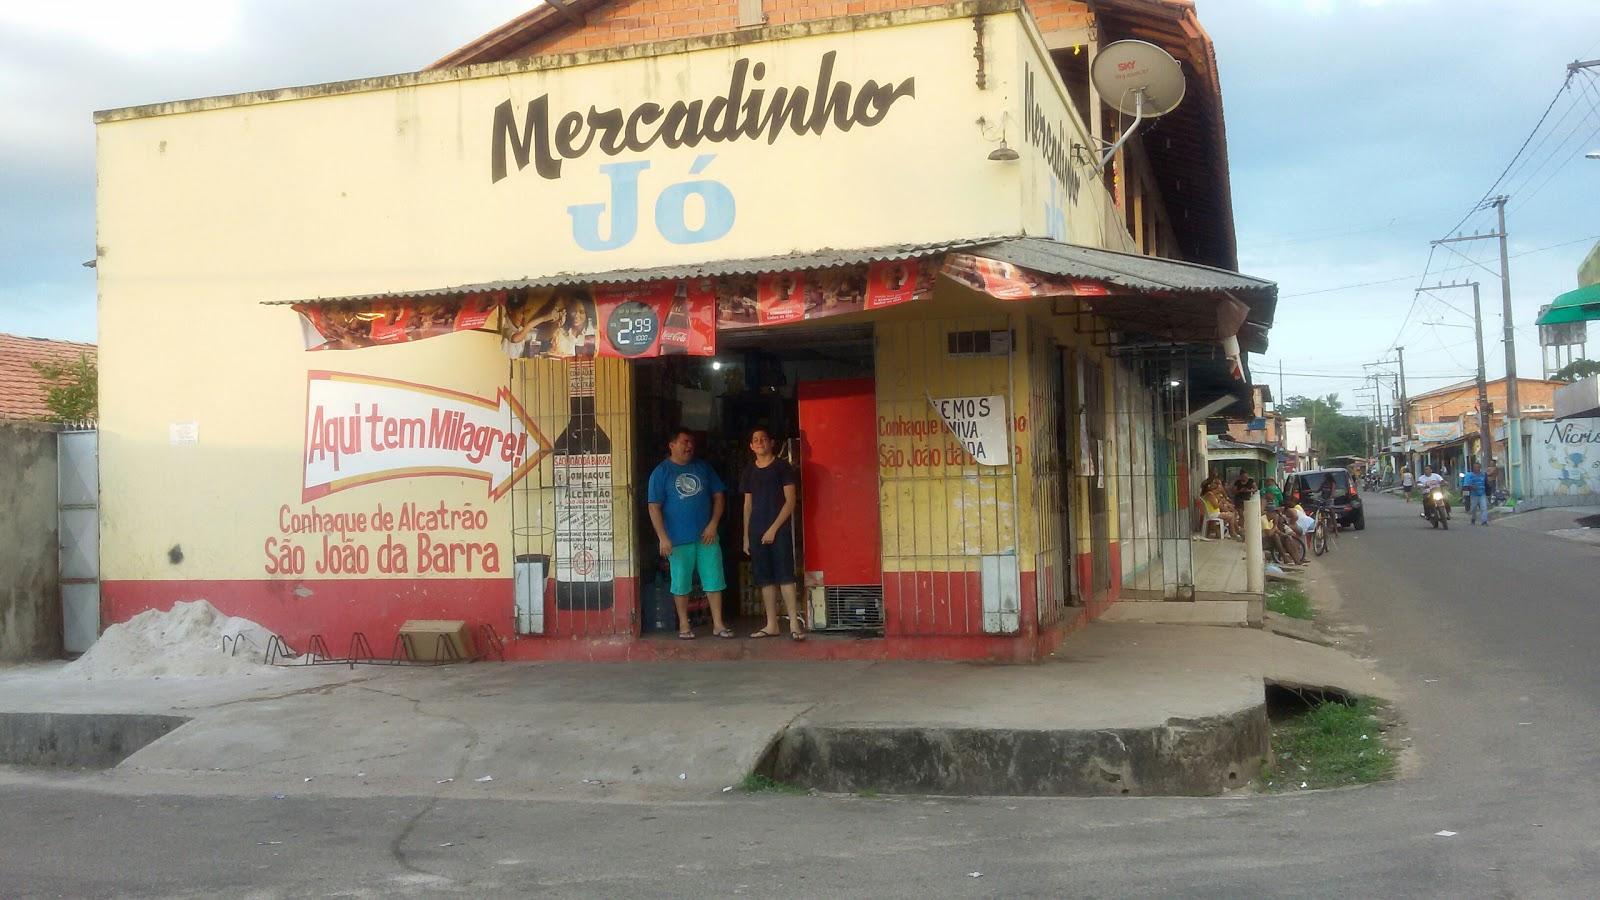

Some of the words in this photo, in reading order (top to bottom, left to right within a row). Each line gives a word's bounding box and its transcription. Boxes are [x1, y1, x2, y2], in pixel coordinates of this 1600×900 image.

[1117, 60, 1136, 71] SKY
[492, 50, 916, 184] Mercadinho
[1025, 61, 1081, 207] Mercadinho
[567, 154, 736, 252] Jó
[308, 403, 362, 471] Aqui
[365, 403, 426, 452] tem
[428, 408, 529, 468] Milagre!
[878, 415, 937, 441] Conhaque
[880, 443, 904, 467] São
[907, 442, 941, 467] João
[279, 504, 367, 542] Conhaque
[370, 503, 394, 531] de
[398, 500, 488, 531] Alcatrão
[264, 536, 305, 575] São
[315, 535, 369, 574] João
[376, 534, 408, 574] da
[417, 532, 500, 574] Barra
